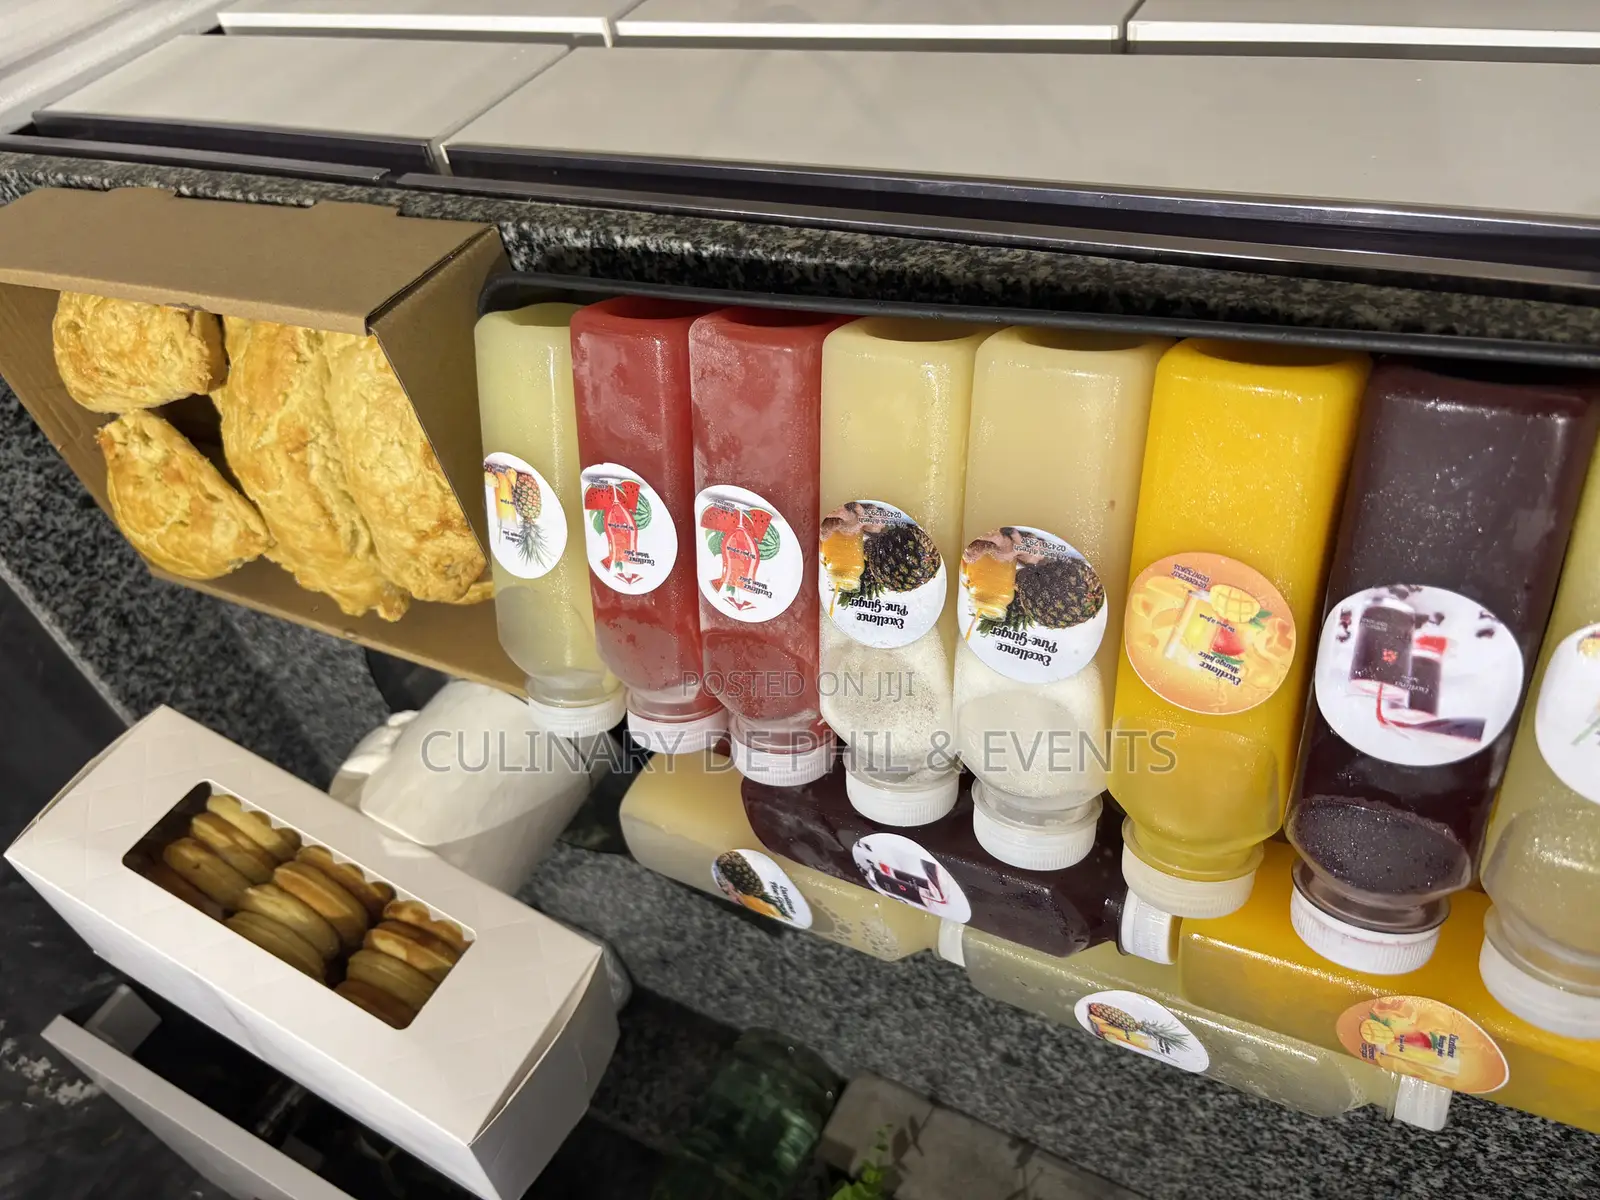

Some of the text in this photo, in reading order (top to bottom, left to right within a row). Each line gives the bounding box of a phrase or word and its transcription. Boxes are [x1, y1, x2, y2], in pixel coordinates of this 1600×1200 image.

[628, 556, 655, 566] Excellence
[744, 584, 772, 598] Excellence
[849, 597, 908, 616] Pine-Ginger
[856, 612, 904, 630] Excellence
[990, 626, 1058, 654] Pine-Ginger
[996, 642, 1052, 667] Excellence
[1198, 651, 1240, 674] Mango juice
[1198, 662, 1242, 686] Excellence
